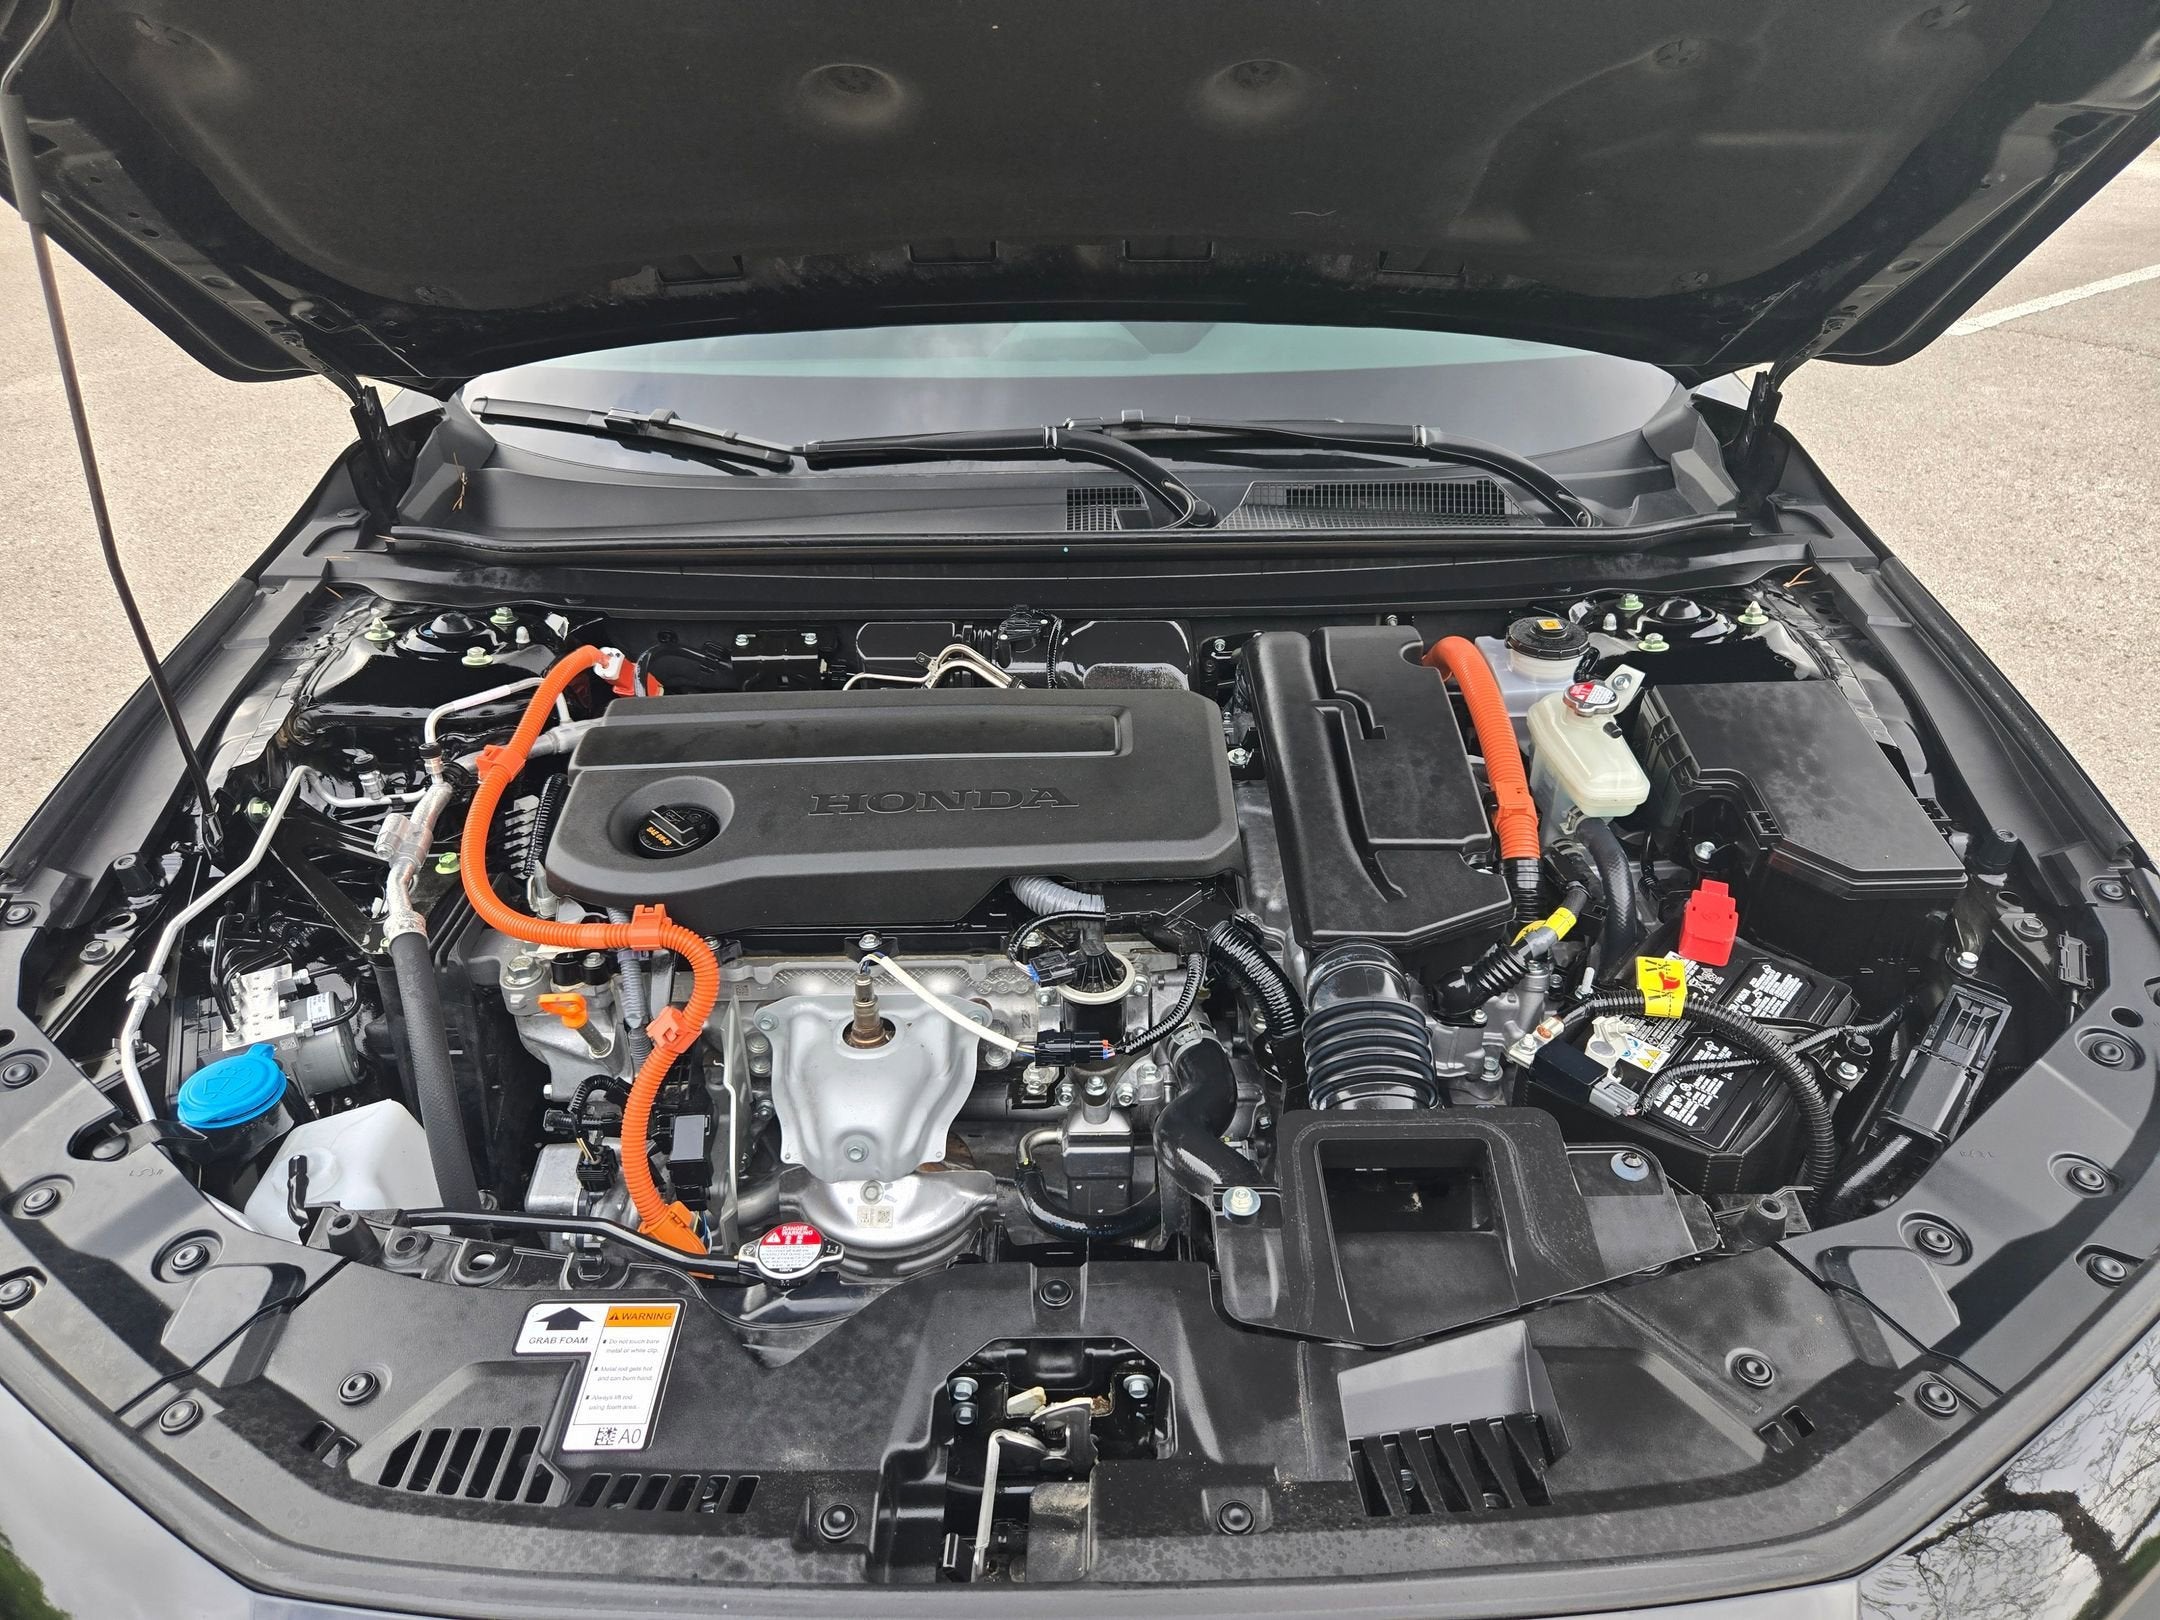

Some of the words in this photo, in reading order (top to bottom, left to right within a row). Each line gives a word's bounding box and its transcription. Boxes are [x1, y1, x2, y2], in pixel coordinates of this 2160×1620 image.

[808, 787, 1080, 816] HONDA
[825, 1245, 840, 1254] 1.1
[621, 1312, 673, 1321] WARNING
[528, 1336, 557, 1345] GRAB
[559, 1336, 589, 1345] FOAM
[617, 1428, 642, 1445] A0
